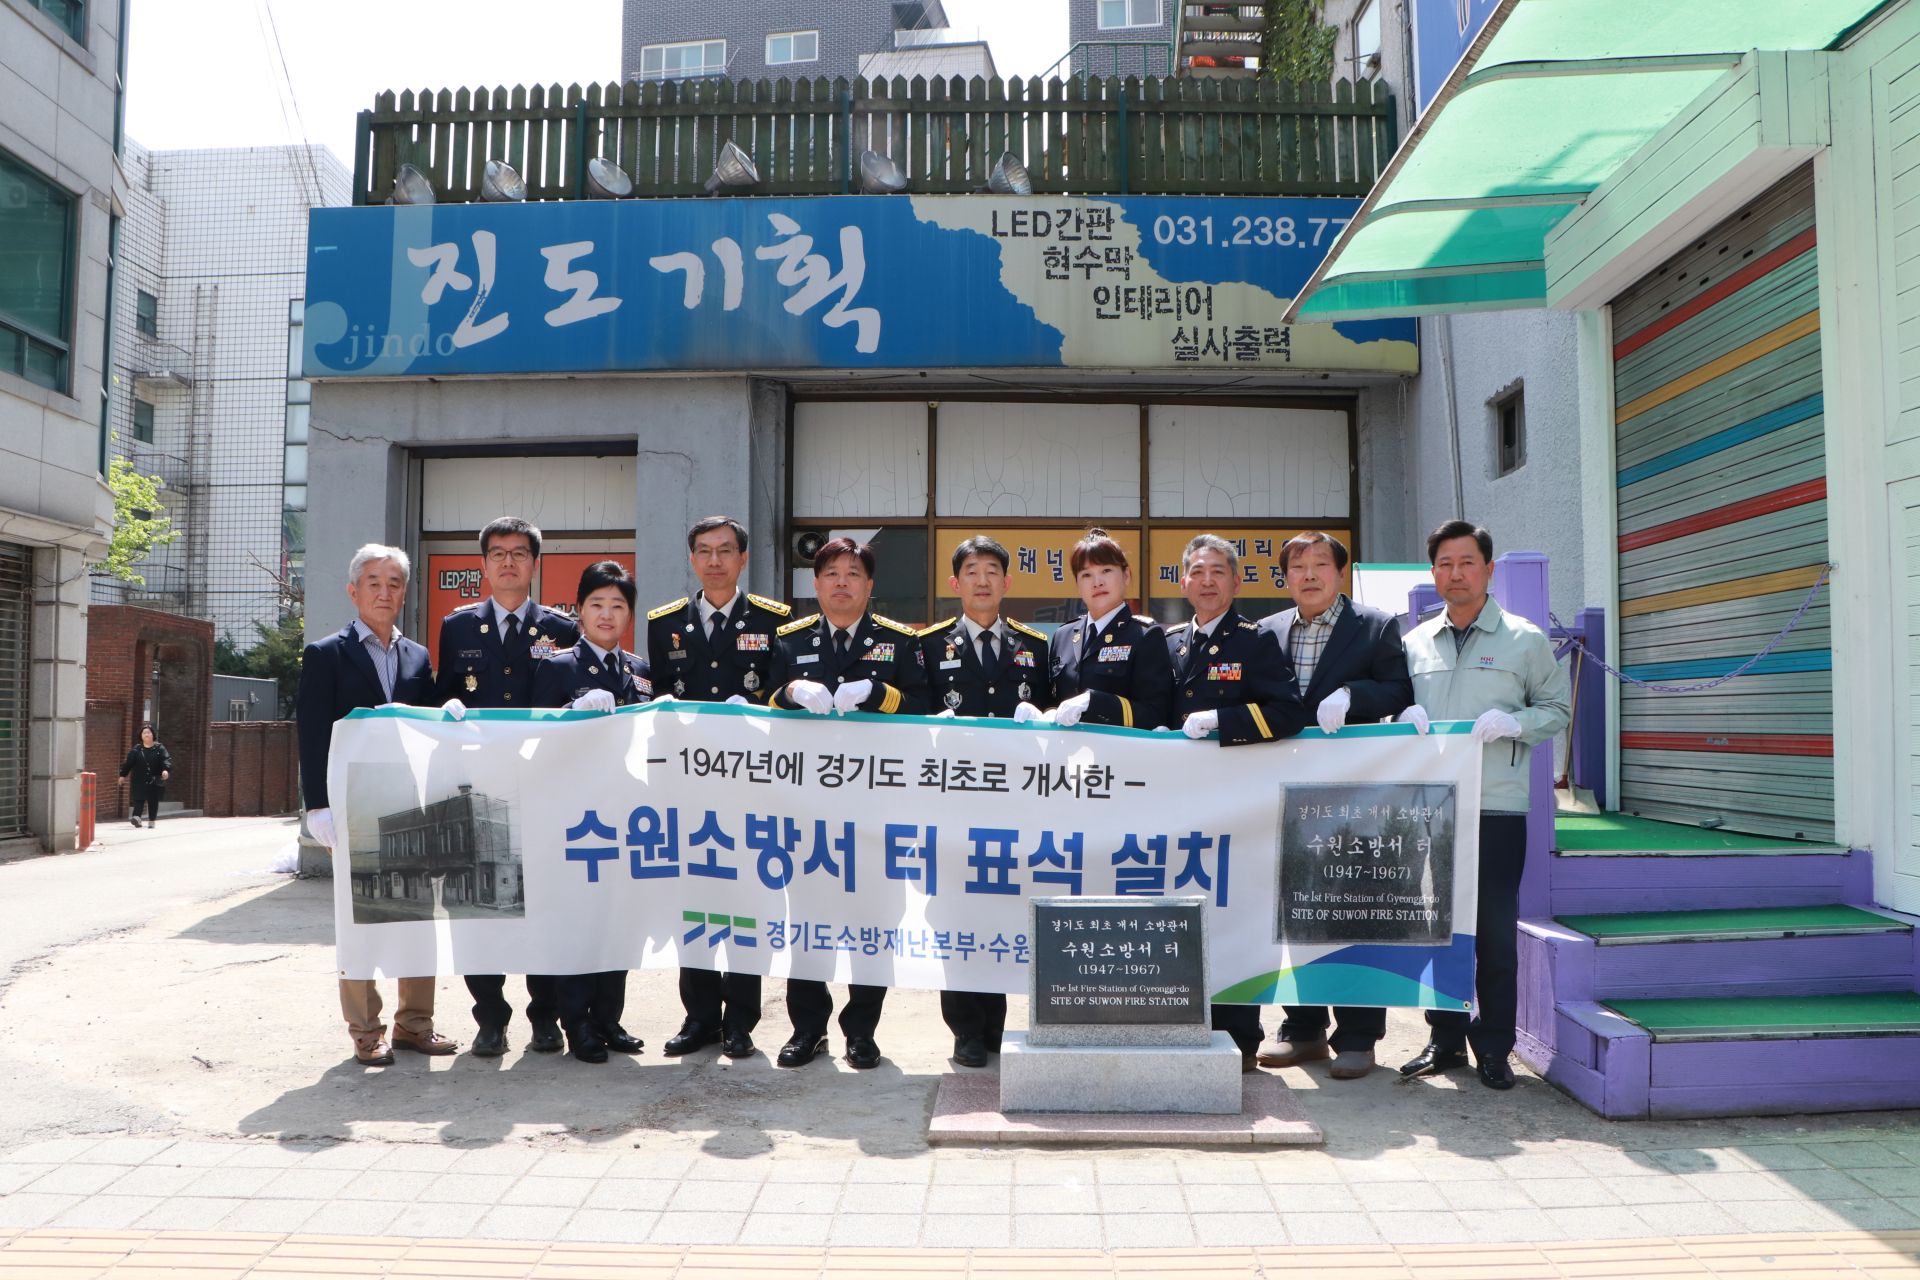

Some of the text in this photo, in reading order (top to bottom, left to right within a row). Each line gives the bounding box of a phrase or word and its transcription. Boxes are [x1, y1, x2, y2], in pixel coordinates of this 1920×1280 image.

[992, 207, 1116, 241] LED간판
[1043, 246, 1134, 281] 현수막
[407, 212, 882, 354] 진도기획
[1093, 285, 1213, 321] 인테리어
[344, 322, 457, 365] jindo
[1171, 325, 1291, 362] 실사출력
[440, 569, 481, 598] LED간판
[678, 747, 1115, 799] 1947년에 경기도 최초로 개서한
[1298, 803, 1443, 822] 경기도 최초 개서 소방관서
[565, 805, 1232, 908] 수원소방서 터 표석 설치
[1306, 834, 1432, 858] 수원소방서 터
[1323, 864, 1411, 880] (1947~1967)
[1292, 891, 1309, 902] The
[1324, 892, 1342, 902] Fire
[1343, 892, 1374, 903] Station
[1376, 892, 1386, 903] of
[1051, 919, 1188, 933] 경기도 최초 개서 소방관서
[1291, 907, 1439, 921] SITE OF SUWON FIRE STATION
[1061, 941, 1179, 959] 수원소방서 터
[1078, 964, 1161, 975] (1947~1967)
[1050, 984, 1067, 993] The
[1080, 984, 1097, 993] Fire
[1098, 984, 1128, 993] Station
[1129, 984, 1138, 993] of
[1139, 984, 1190, 995] Gyeonggi-do
[1050, 996, 1190, 1006] SITE OF SUWON FIRE STATION
